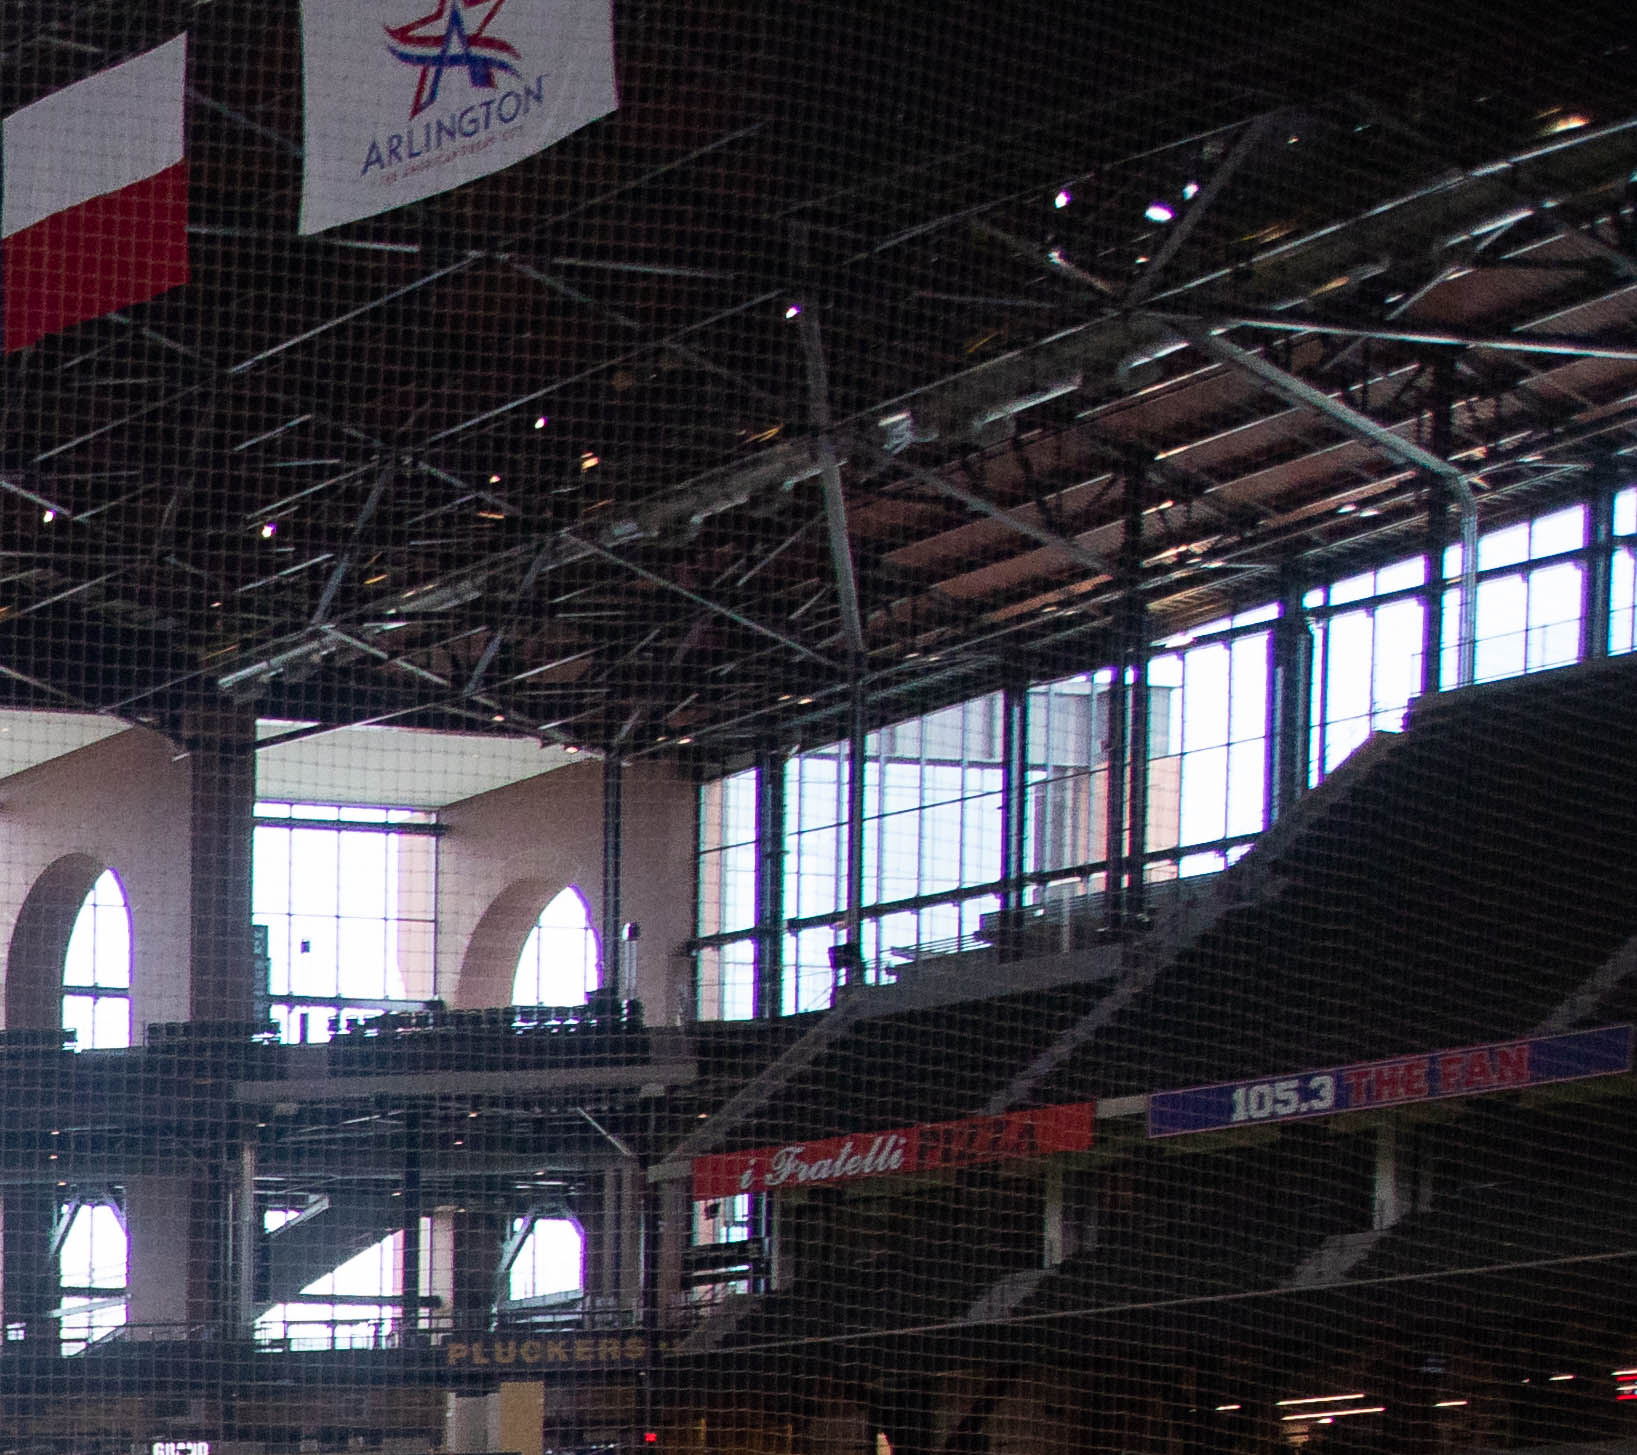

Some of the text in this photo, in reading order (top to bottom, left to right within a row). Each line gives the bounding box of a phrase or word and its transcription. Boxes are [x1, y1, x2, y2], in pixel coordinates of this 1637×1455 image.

[360, 73, 549, 177] ARLINGTON
[1230, 1045, 1531, 1122] 105.3 THE FAN
[739, 1159, 757, 1189] i
[764, 1135, 908, 1187] Fratelli
[448, 1336, 646, 1365] PLUCKERS
